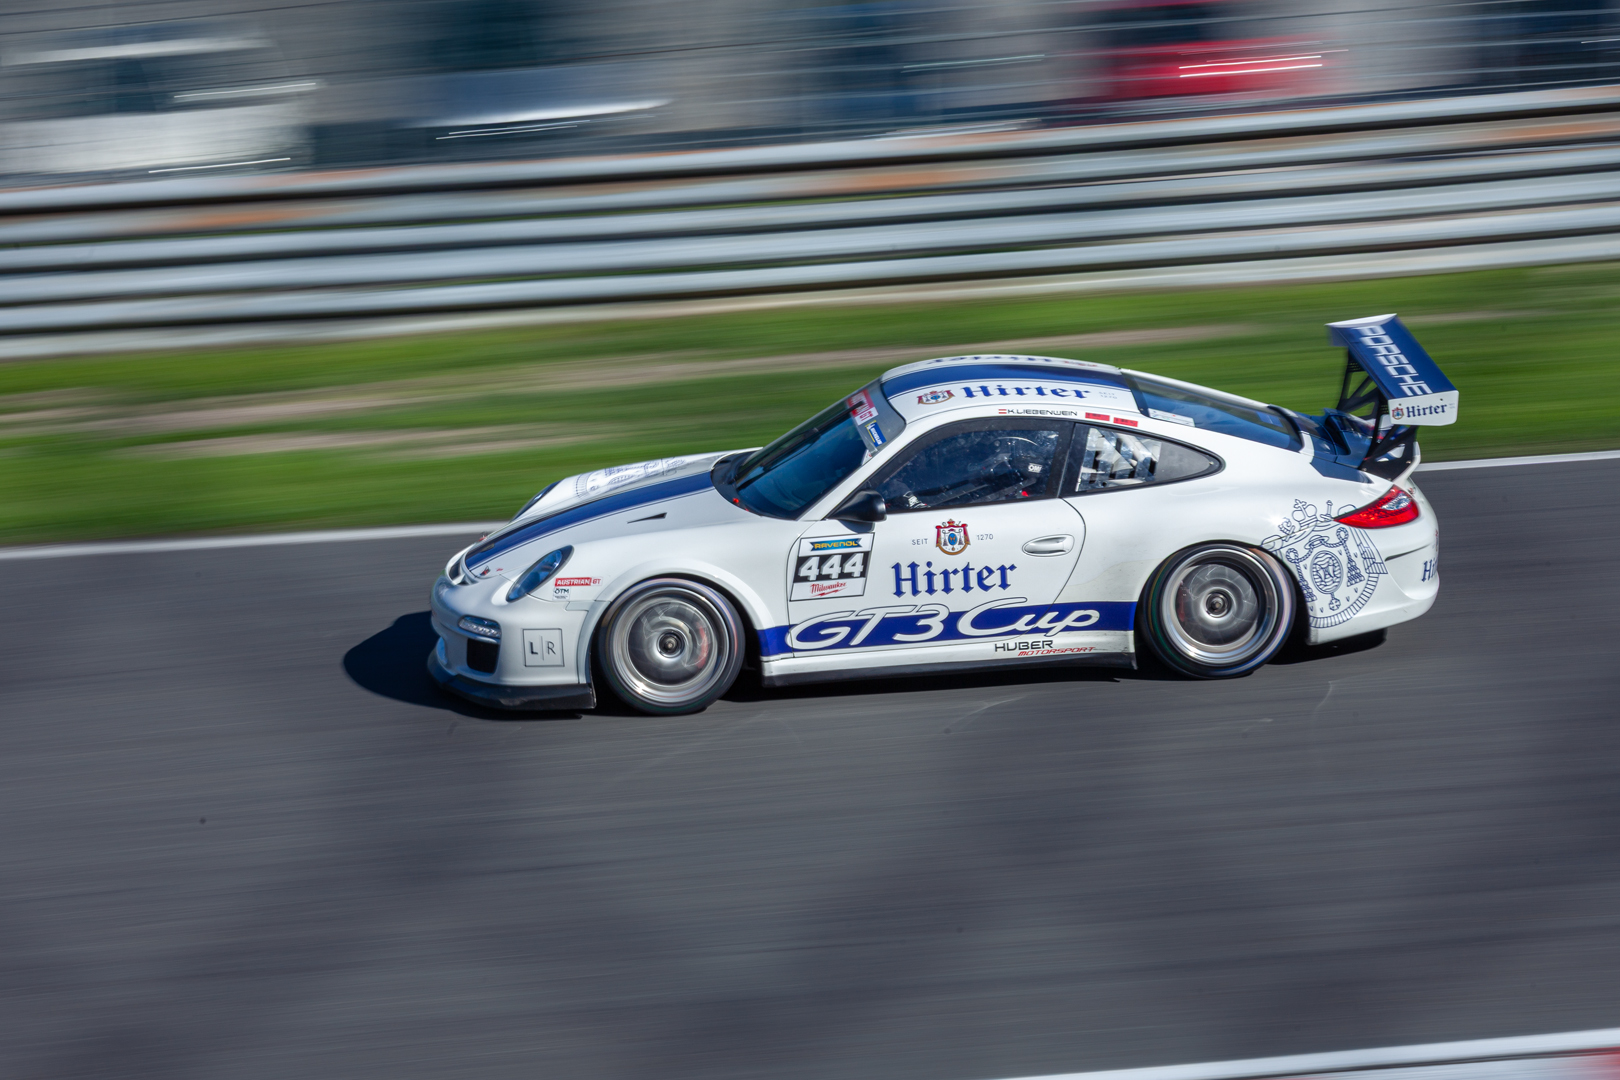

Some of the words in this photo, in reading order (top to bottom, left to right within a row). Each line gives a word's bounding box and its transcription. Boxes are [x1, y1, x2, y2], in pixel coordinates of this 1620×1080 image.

[1352, 325, 1433, 396] PORSCHE
[961, 384, 1091, 399] Hirter
[1406, 404, 1448, 418] Hirter
[814, 540, 858, 549] RAVENOL
[911, 538, 929, 546] SEIT
[976, 533, 994, 541] 1270
[798, 552, 865, 581] 444
[891, 560, 1018, 598] Hirter
[956, 596, 1100, 638] Cup
[994, 639, 1054, 653] HUBER
[1017, 646, 1096, 657] MOTORSPORT
